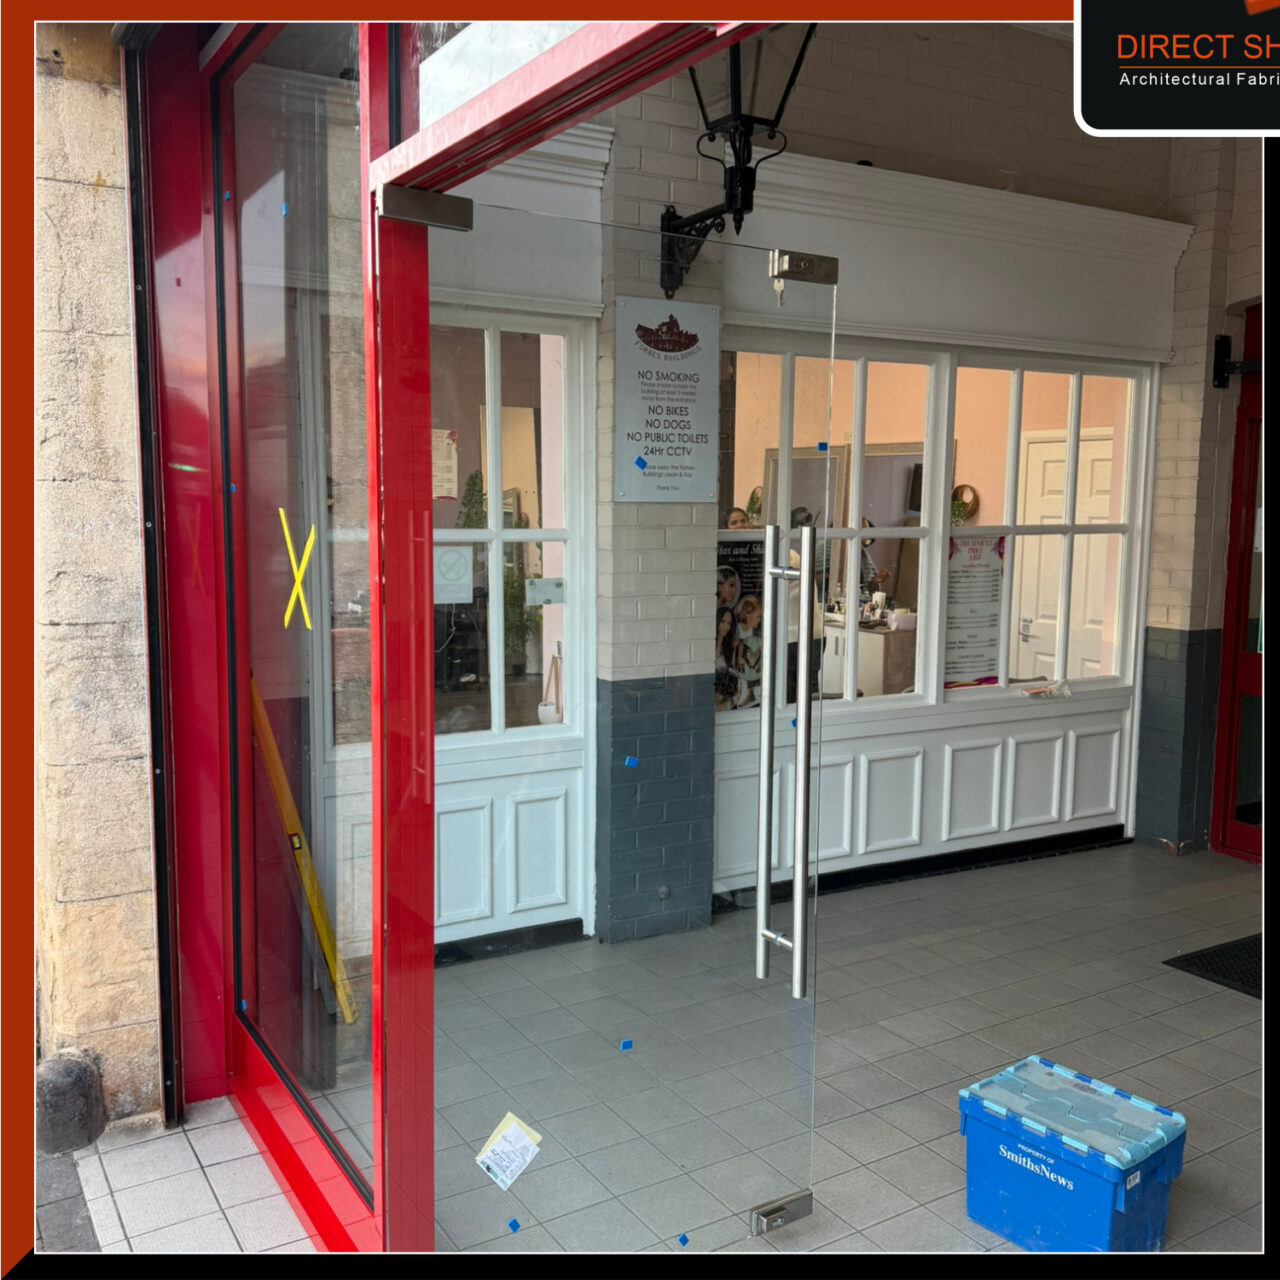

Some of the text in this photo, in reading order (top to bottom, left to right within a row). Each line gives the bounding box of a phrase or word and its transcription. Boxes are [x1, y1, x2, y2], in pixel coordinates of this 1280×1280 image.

[638, 370, 700, 383] NO SMOKING
[648, 405, 689, 416] NO BIKES
[645, 419, 692, 430] NO DOGS
[627, 431, 709, 444] NO PUBLIC TOILETS
[644, 446, 692, 456] 24Hr CCTV
[1018, 1144, 1055, 1165] PROPERTY OF
[999, 1144, 1074, 1191] SmithsNews
